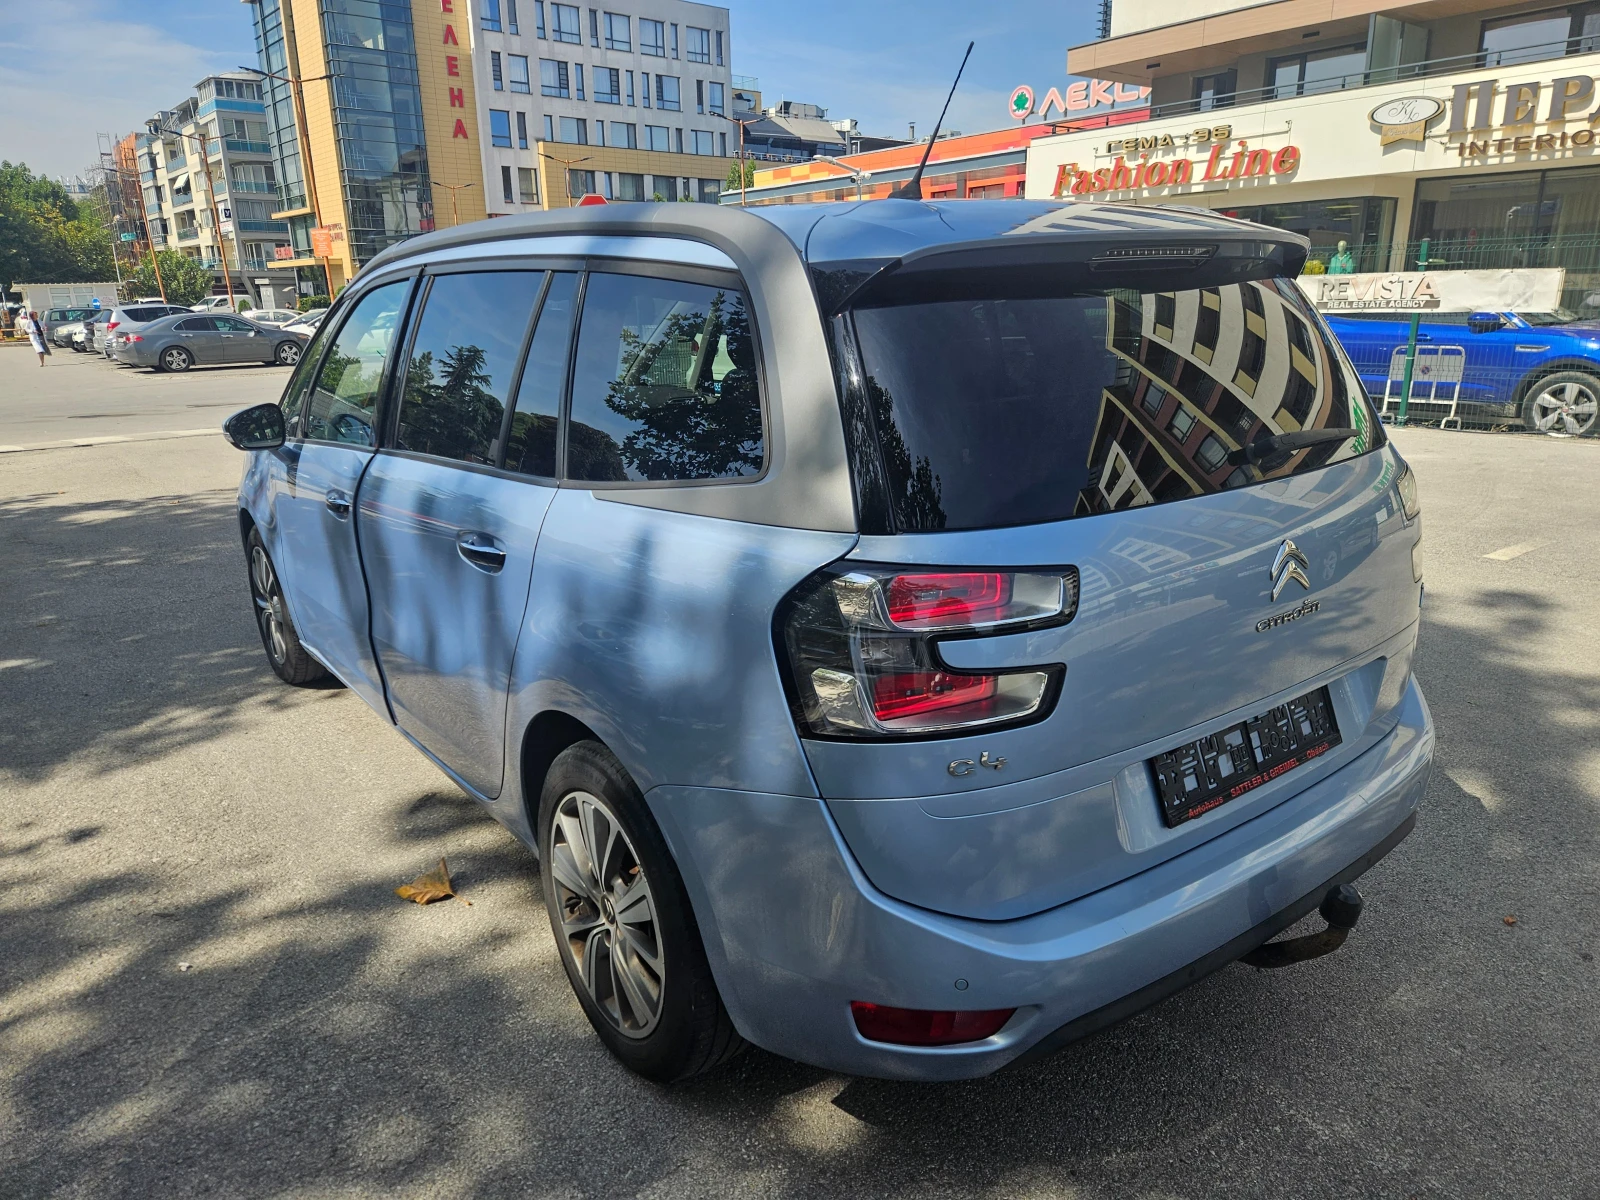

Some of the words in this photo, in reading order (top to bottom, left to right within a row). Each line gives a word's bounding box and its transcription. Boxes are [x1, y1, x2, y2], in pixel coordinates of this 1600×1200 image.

[1446, 75, 1600, 133] ПЕР
[1458, 129, 1600, 157] INTERIO
[1050, 153, 1193, 197] Fashion
[1201, 140, 1301, 181] Line
[1316, 275, 1441, 301] REVISTA
[1327, 301, 1351, 309] REAL
[1352, 300, 1386, 308] ESTATE
[1388, 300, 1427, 308] AGENCY
[948, 750, 1008, 777] C4
[1188, 795, 1224, 818] Autohaus
[1230, 775, 1263, 797] SATTLER
[1263, 772, 1269, 781] &
[1269, 757, 1300, 778] GREIMEL
[1306, 741, 1330, 759] Obdach
